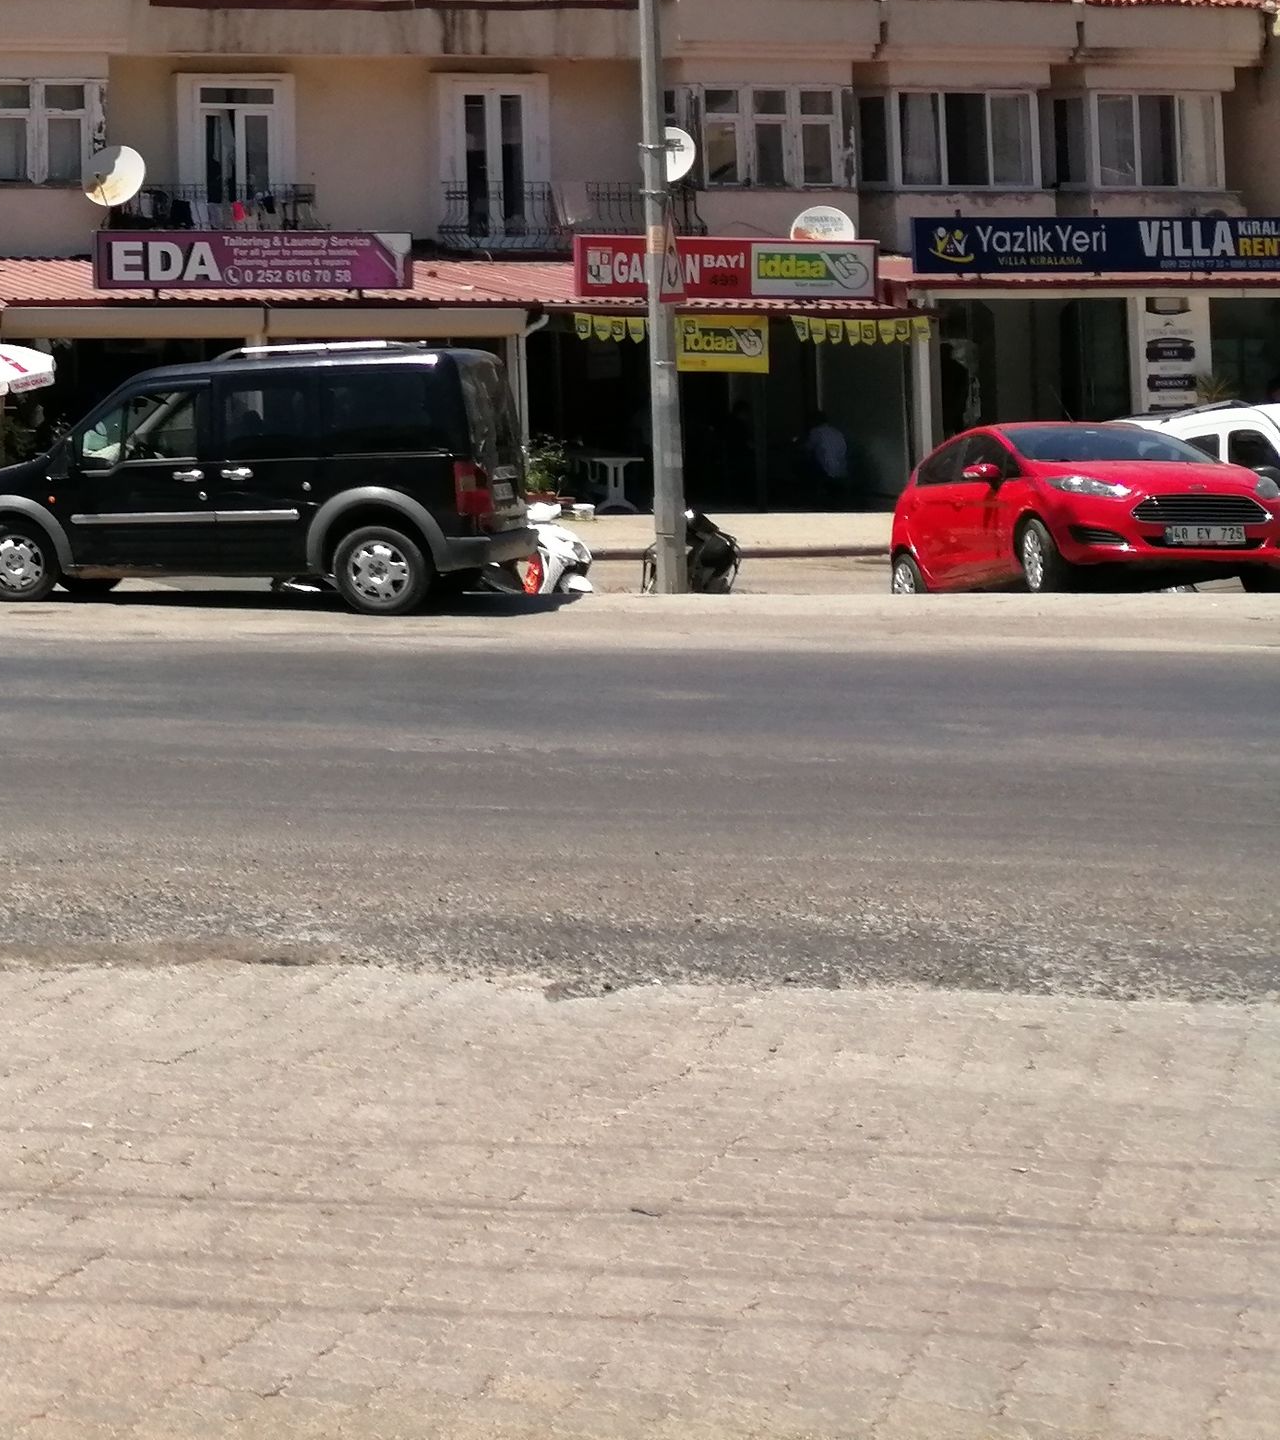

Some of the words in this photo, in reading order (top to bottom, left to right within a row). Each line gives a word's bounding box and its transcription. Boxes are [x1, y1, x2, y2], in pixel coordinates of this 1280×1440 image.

[222, 236, 270, 248] Tailoring
[272, 237, 281, 246] &
[284, 236, 328, 248] Laundry
[330, 236, 371, 246] Service
[976, 225, 1053, 252] Yazlık
[1056, 224, 1106, 252] Yeri
[111, 241, 221, 281] EDA
[759, 255, 827, 278] iddaa
[244, 270, 253, 282] 0
[256, 270, 282, 283] 252
[684, 327, 736, 351] iddaa
[1174, 528, 1188, 539] 48
[1197, 528, 1211, 539] EY
